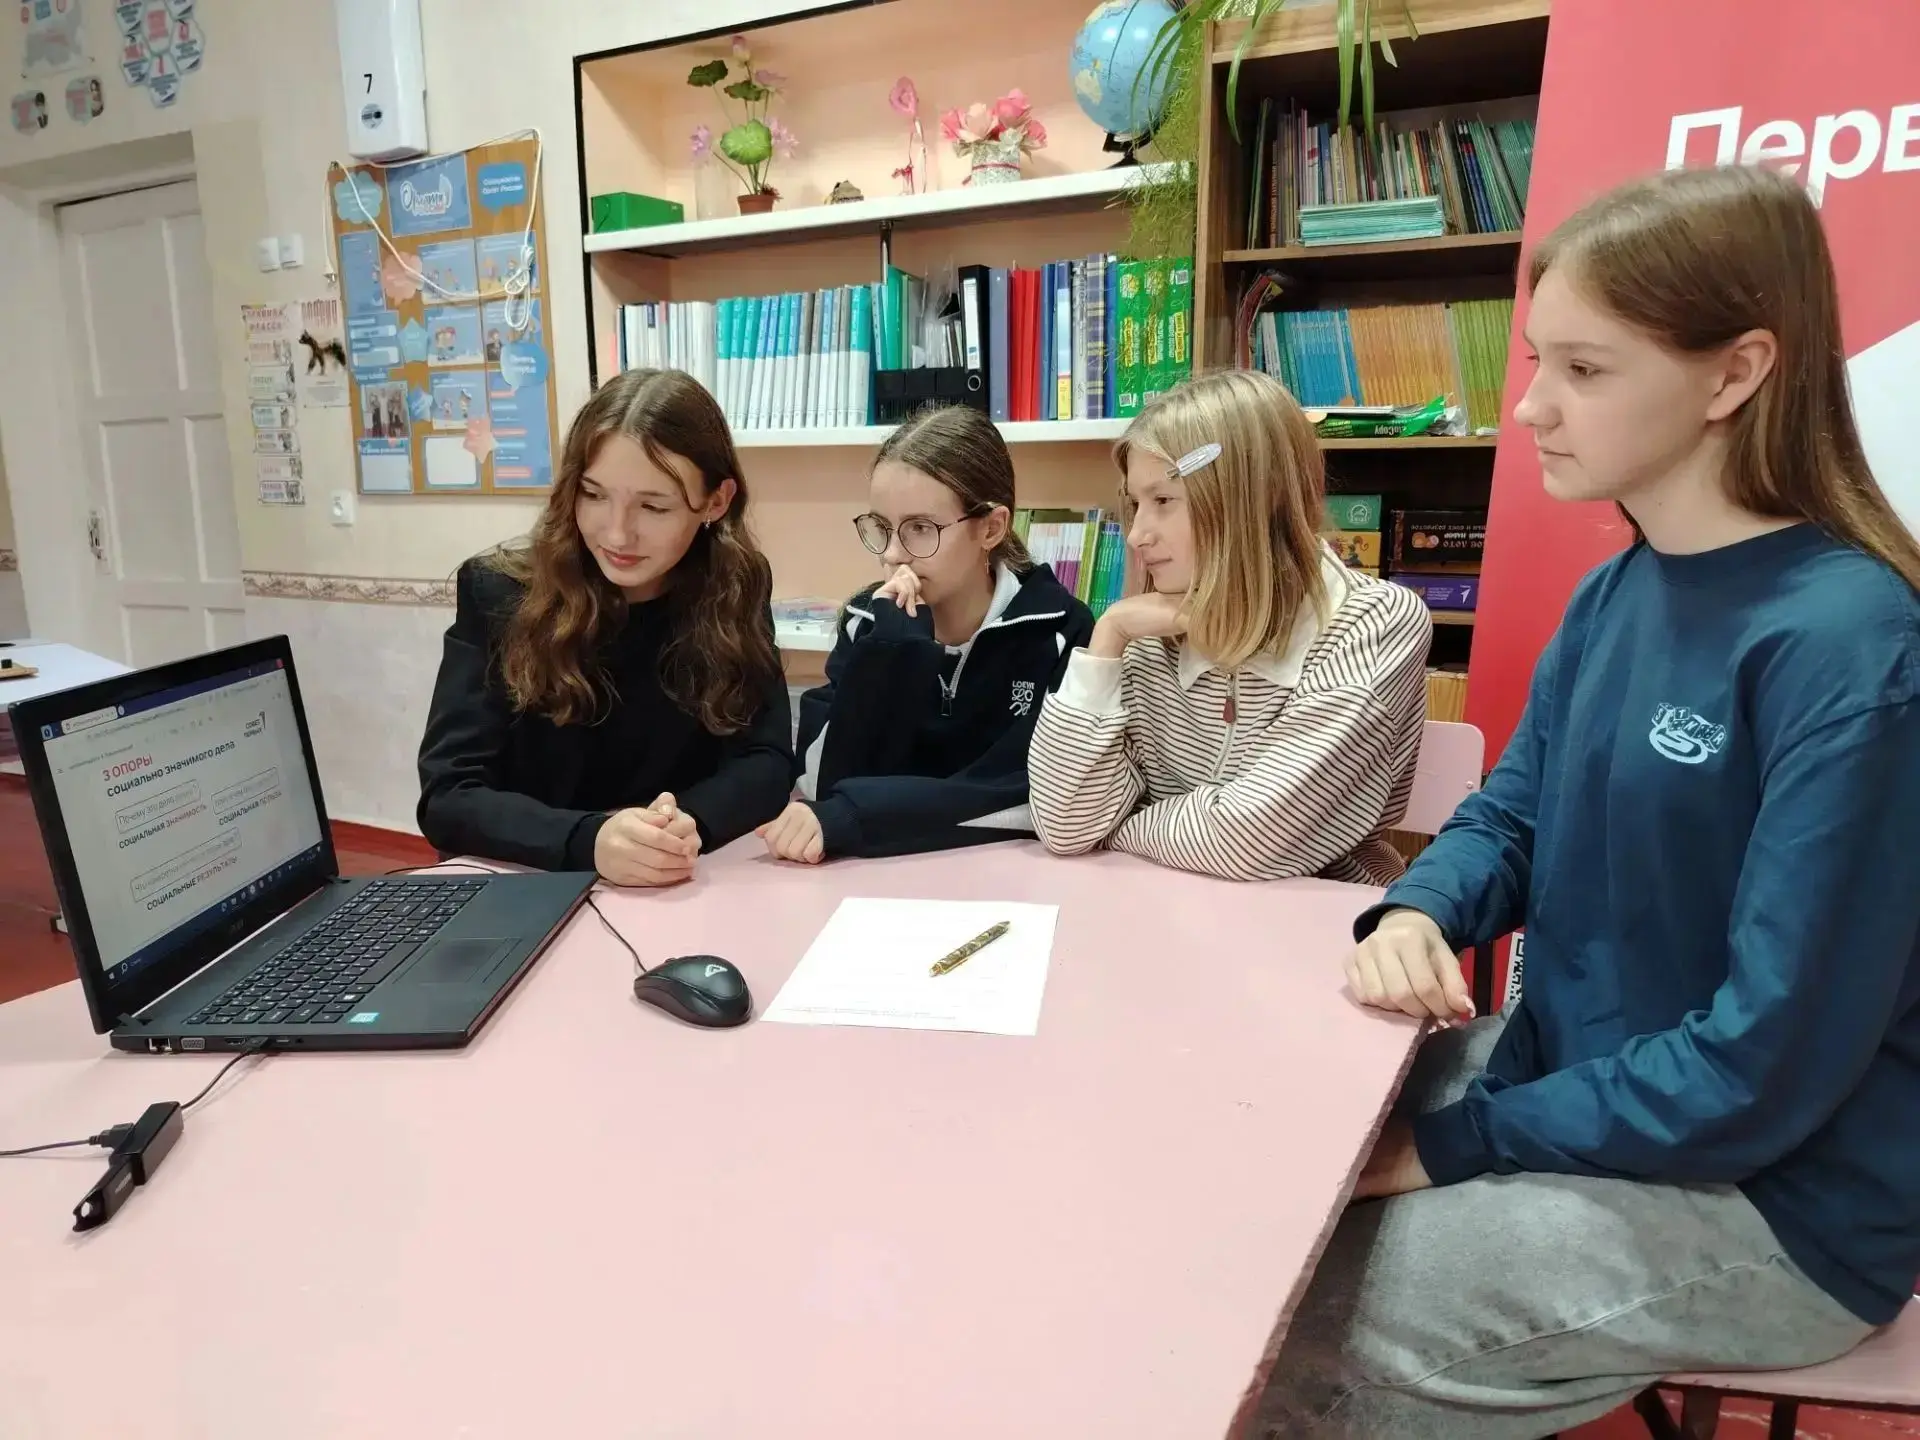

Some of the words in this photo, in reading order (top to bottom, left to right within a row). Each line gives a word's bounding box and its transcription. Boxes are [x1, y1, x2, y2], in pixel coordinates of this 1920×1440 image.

[363, 73, 372, 94] 7
[107, 768, 164, 797] социально
[165, 749, 214, 775] значимого
[214, 740, 236, 757] дела
[112, 754, 153, 779] ОПОРЫ
[219, 800, 259, 826] СОЦИАЛЬНАЯ
[119, 822, 166, 849] СОЦИАЛЬНАЯ
[146, 878, 197, 911] СОЦИАЛЬНЫЕ
